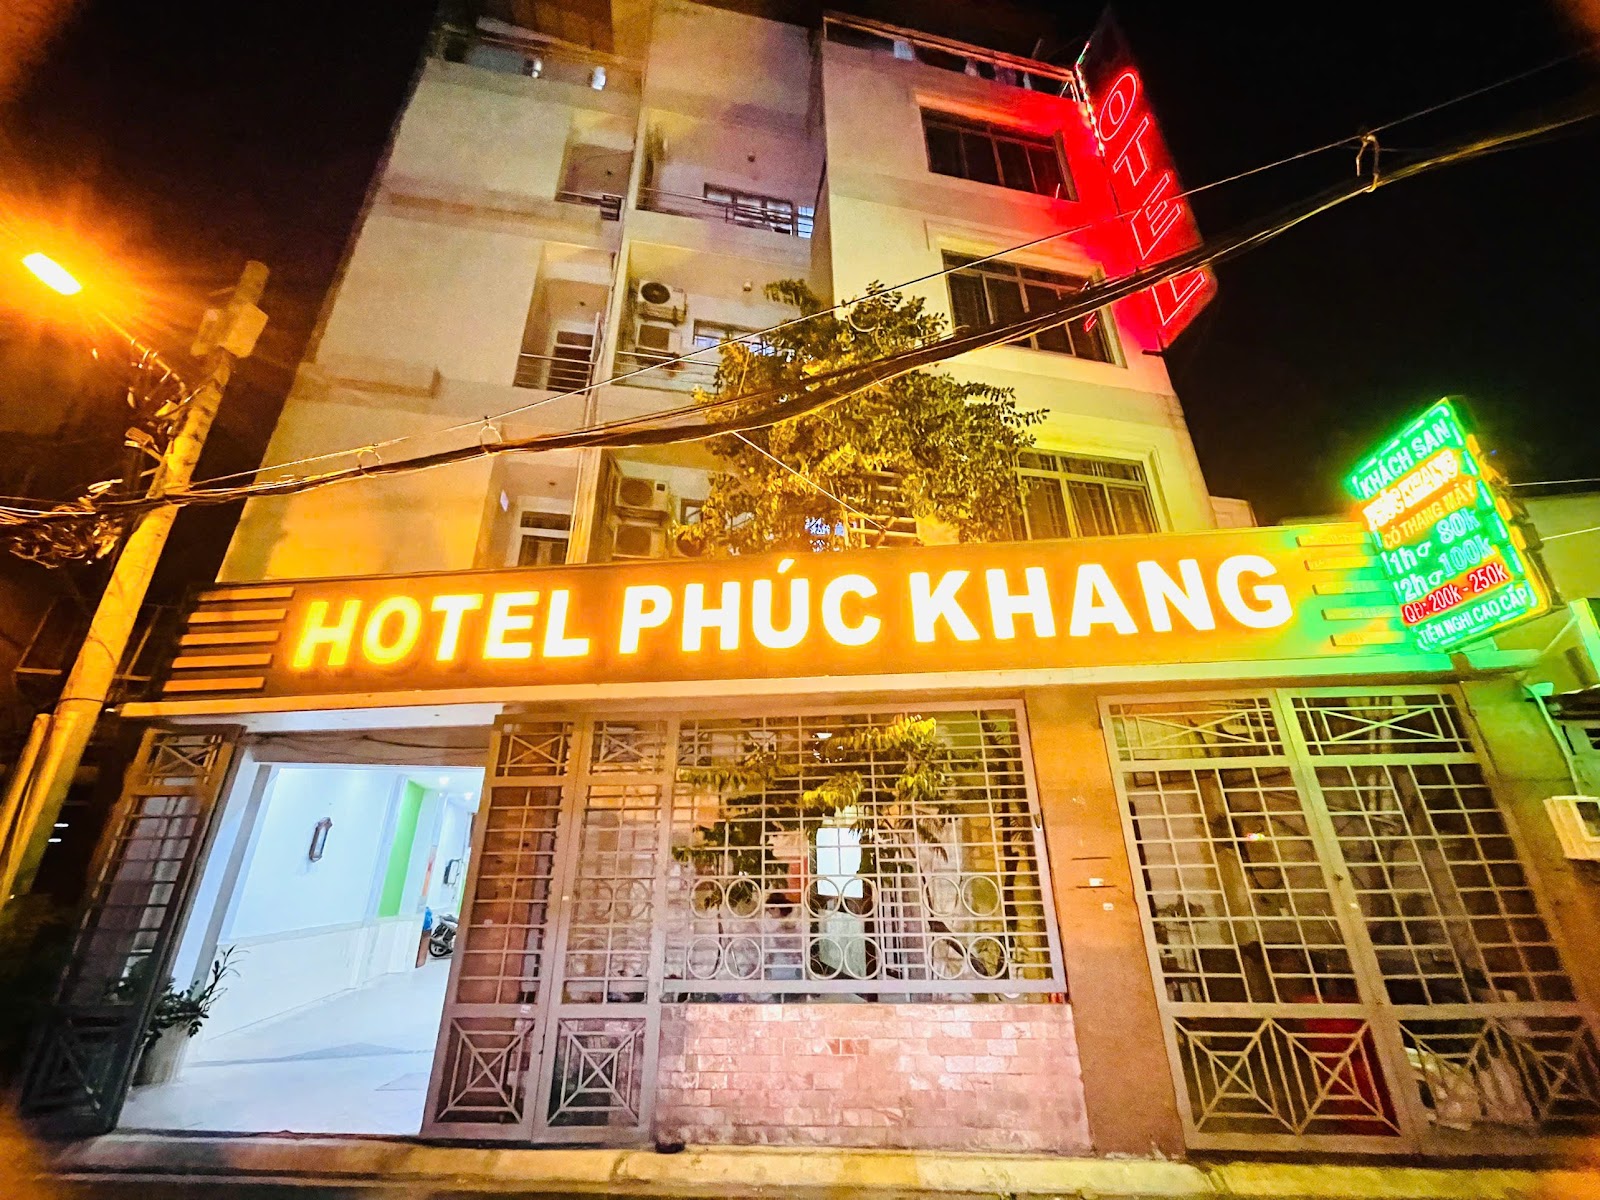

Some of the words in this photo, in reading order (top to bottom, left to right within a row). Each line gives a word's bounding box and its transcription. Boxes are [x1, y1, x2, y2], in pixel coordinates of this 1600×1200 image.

[1359, 447, 1415, 499] KHÁCH
[1400, 501, 1444, 538] THANG
[293, 589, 590, 668] HOTEL
[619, 555, 881, 655] PHÚC
[909, 554, 1293, 643] KHANG
[1472, 599, 1501, 623] CAO
